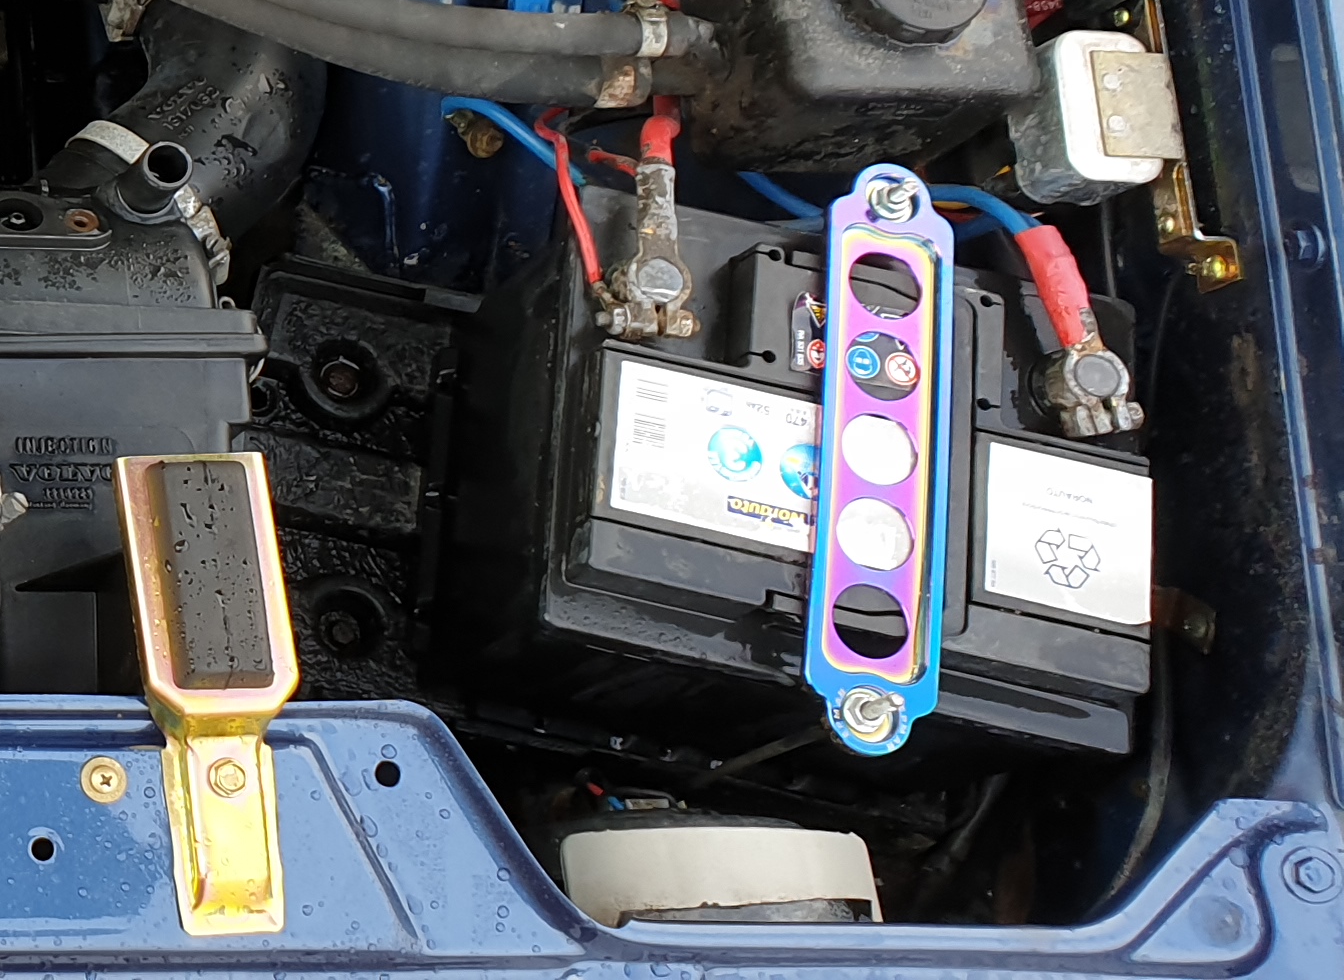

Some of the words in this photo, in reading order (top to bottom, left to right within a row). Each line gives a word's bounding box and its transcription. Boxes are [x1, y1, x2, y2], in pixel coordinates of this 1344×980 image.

[785, 412, 808, 427] 470
[15, 436, 114, 455] INJECTION
[9, 462, 113, 483] VOLVO
[728, 496, 808, 525] Norauto
